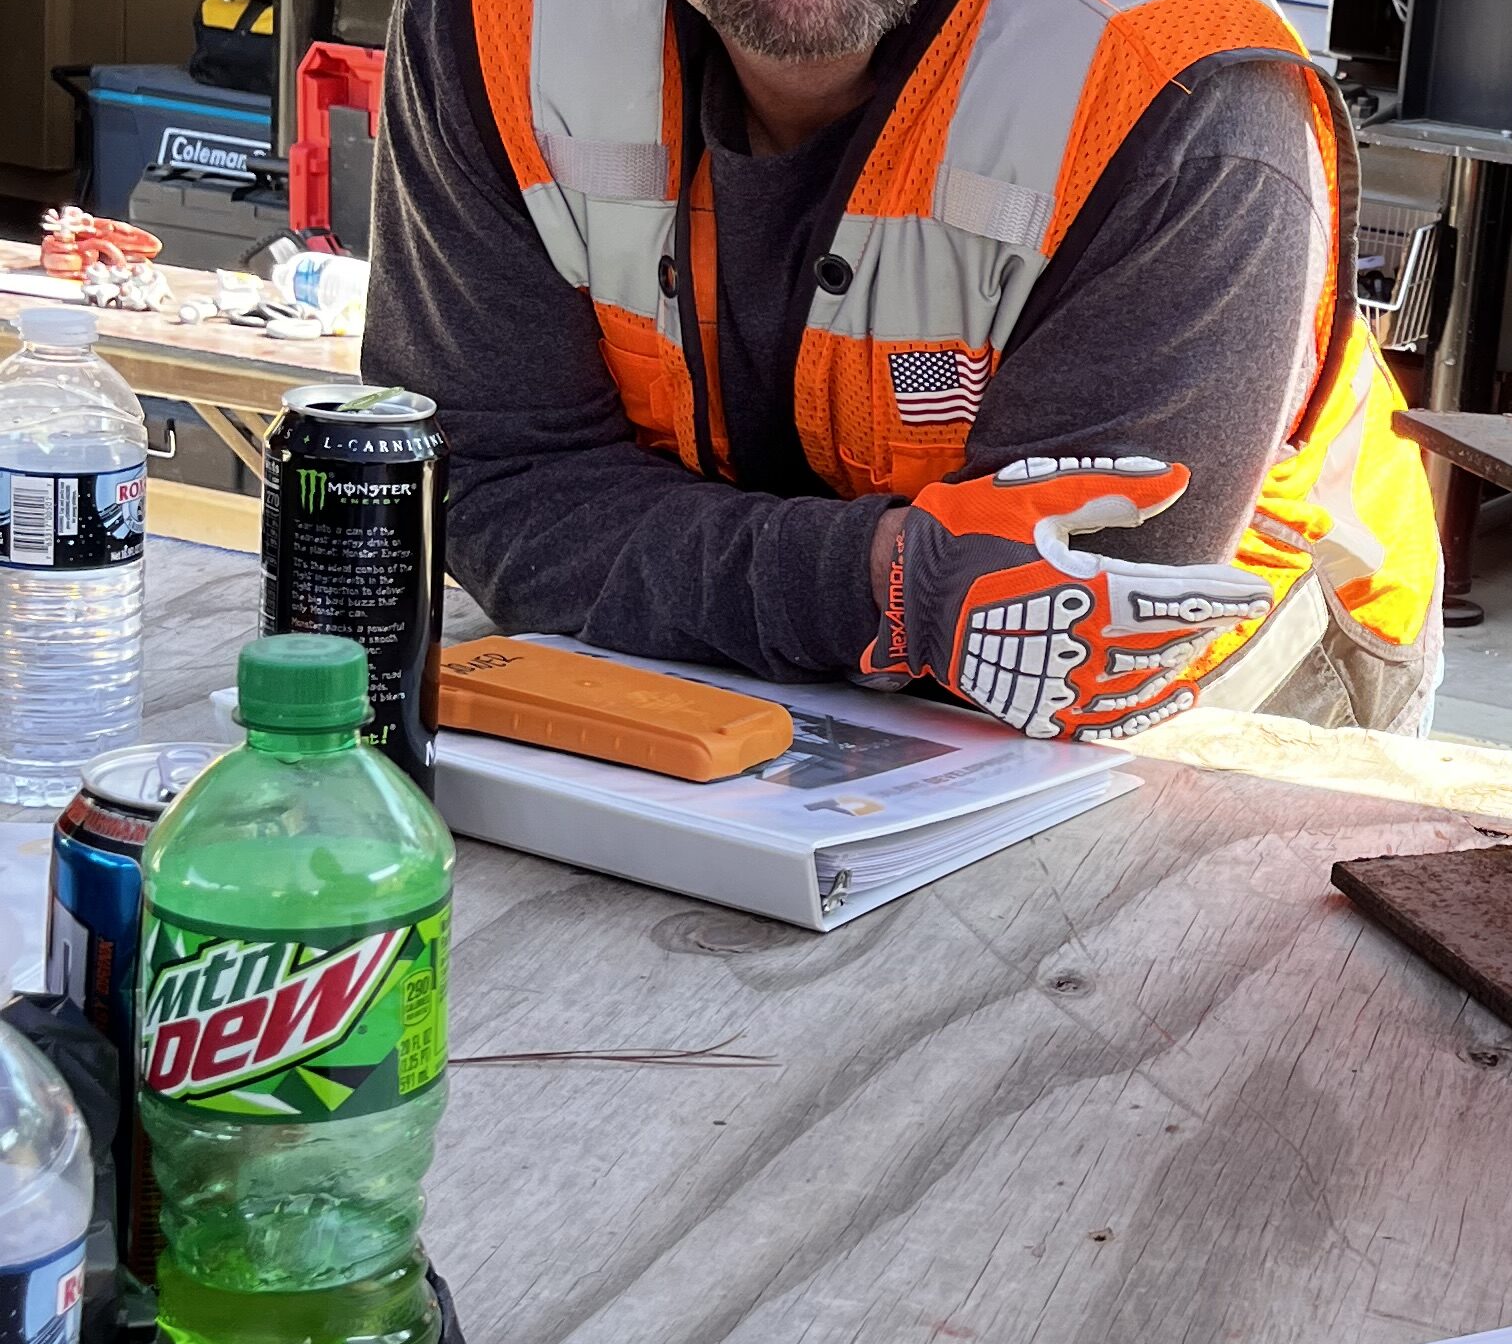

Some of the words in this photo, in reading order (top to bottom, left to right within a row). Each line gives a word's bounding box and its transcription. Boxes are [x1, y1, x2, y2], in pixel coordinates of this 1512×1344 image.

[328, 482, 412, 496] MONSTER
[348, 597, 375, 606] buzz
[885, 561, 909, 658] HexArmor
[407, 977, 429, 1002] 290
